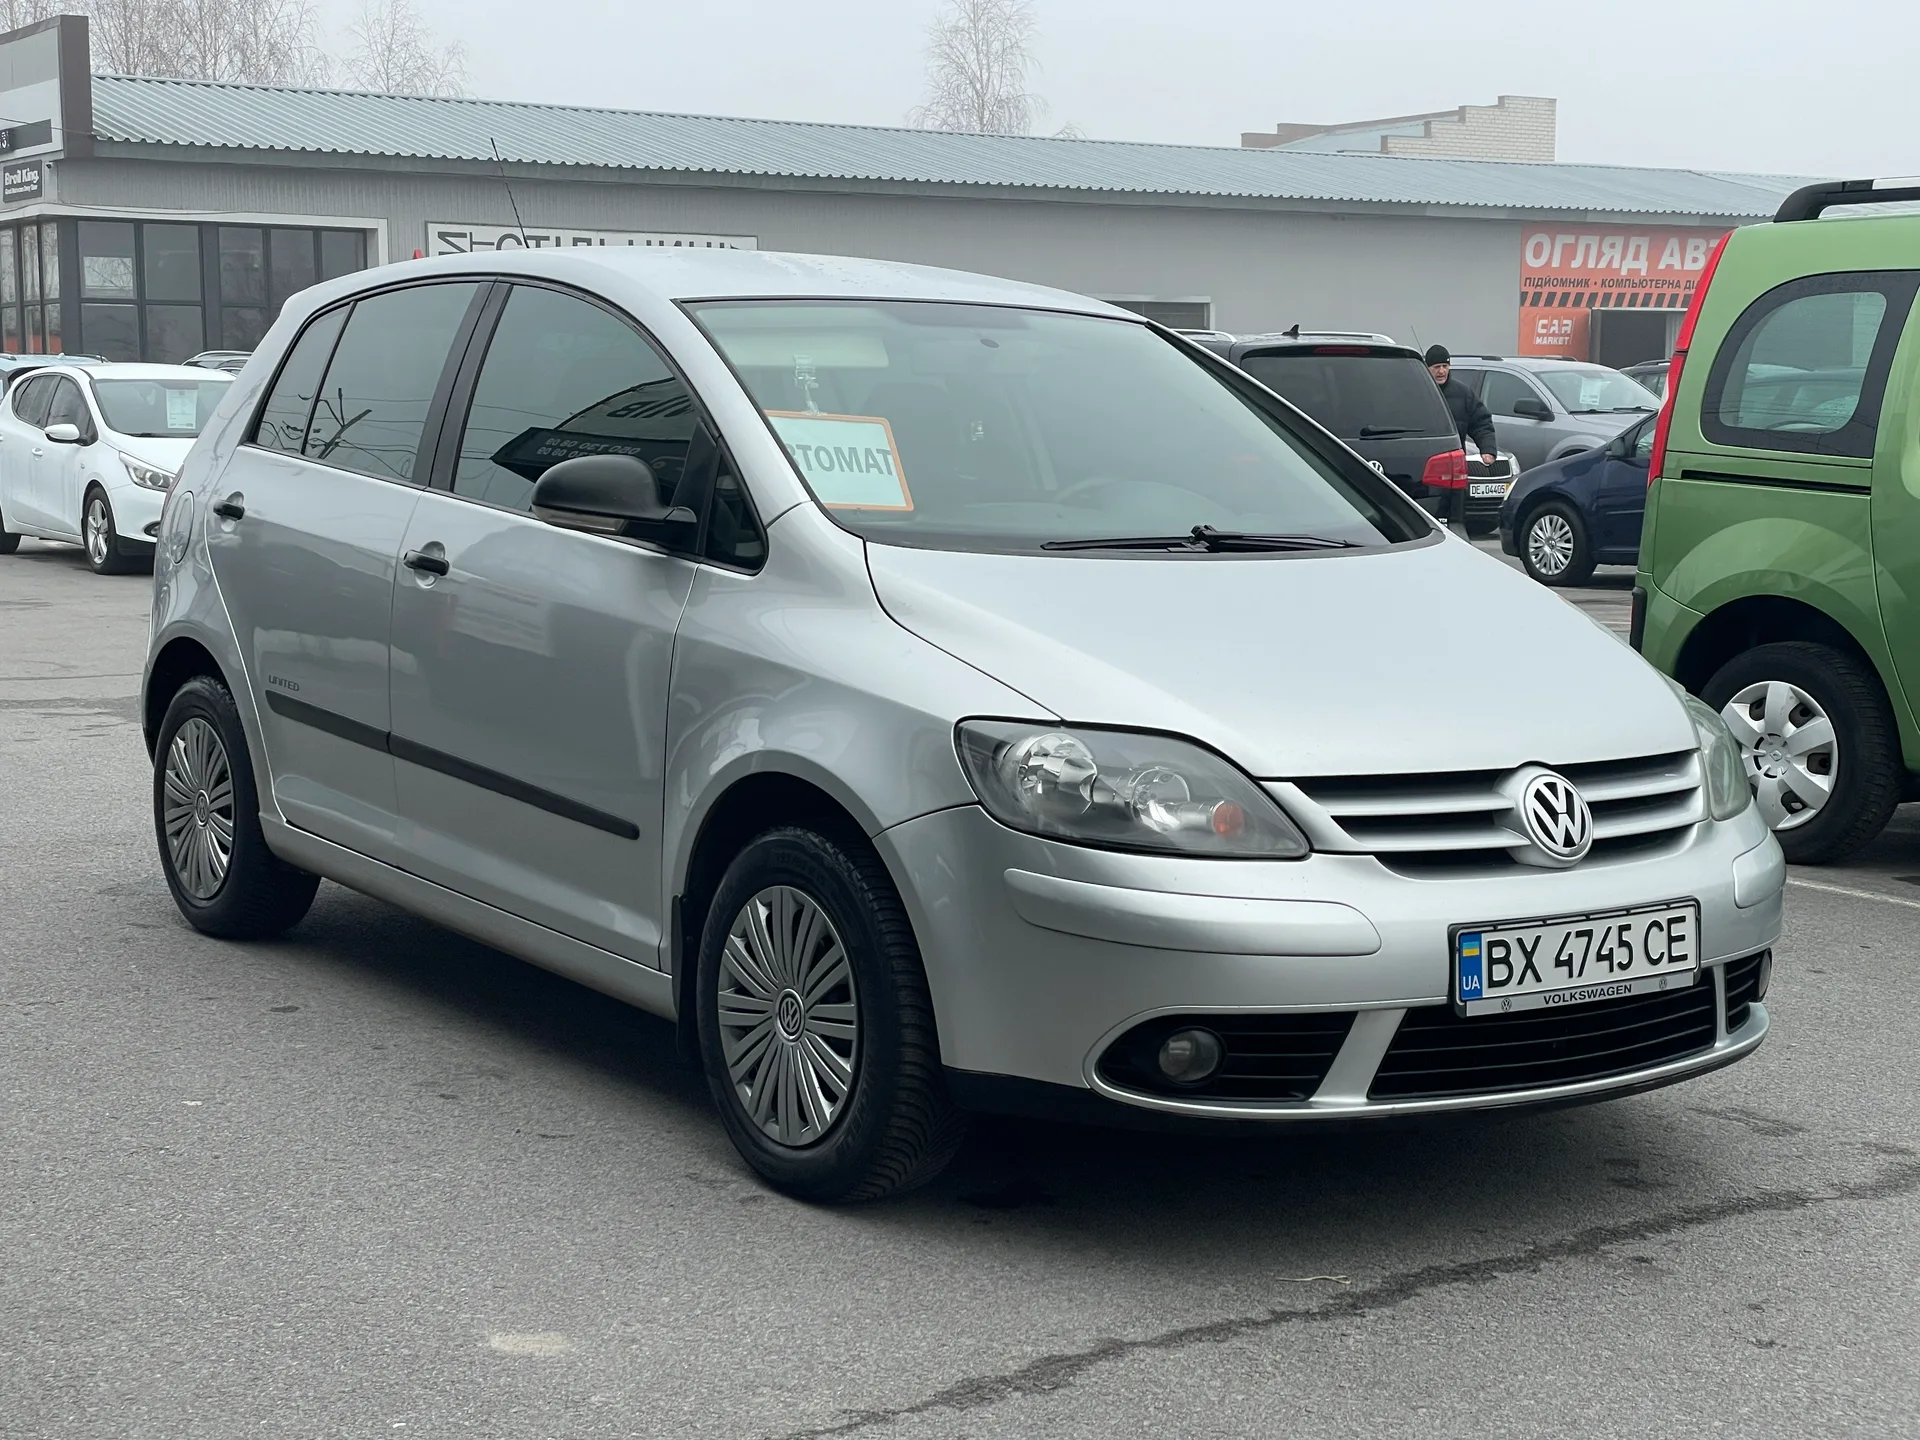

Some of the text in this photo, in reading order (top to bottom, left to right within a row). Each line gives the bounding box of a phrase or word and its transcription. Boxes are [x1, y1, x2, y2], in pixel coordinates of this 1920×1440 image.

[1525, 233, 1650, 276] ОГЛЯД
[1524, 276, 1591, 290] ПІДЙОМНИК
[1537, 319, 1573, 334] CAR
[1535, 336, 1570, 345] MARKET
[268, 675, 300, 691] UNITED
[1487, 915, 1689, 989] BX 4745 CE
[1463, 975, 1481, 991] UA
[1543, 984, 1632, 1005] VOLKSWAGEN
